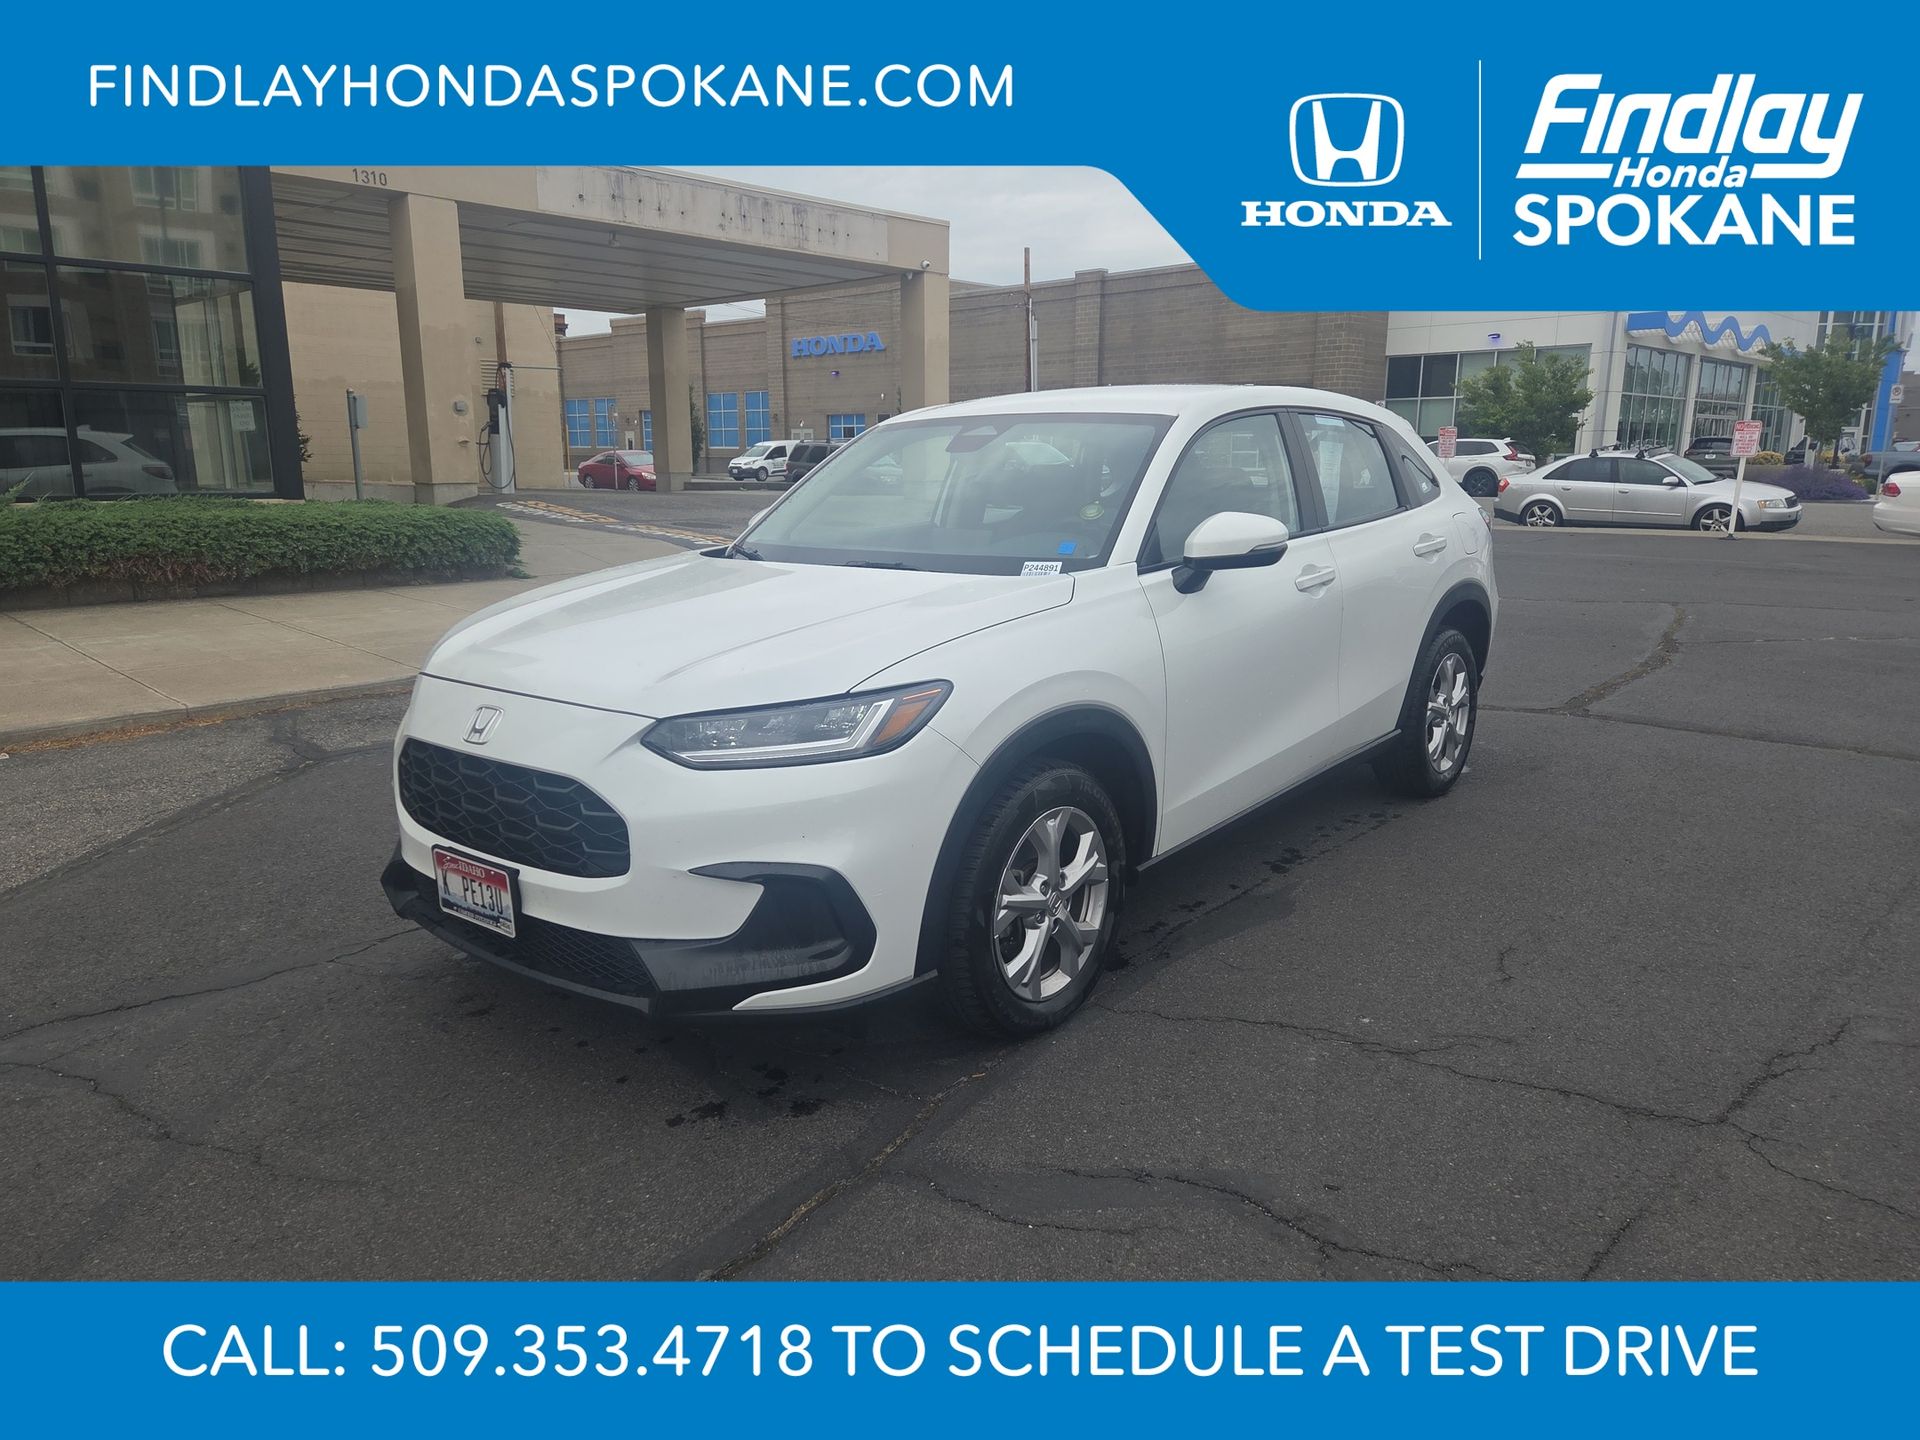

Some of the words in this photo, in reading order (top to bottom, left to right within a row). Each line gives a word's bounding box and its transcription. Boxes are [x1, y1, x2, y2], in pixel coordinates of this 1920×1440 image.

[352, 168, 387, 186] 1310
[791, 331, 886, 358] HONDA
[1023, 564, 1059, 572] P244891
[441, 869, 451, 896] K
